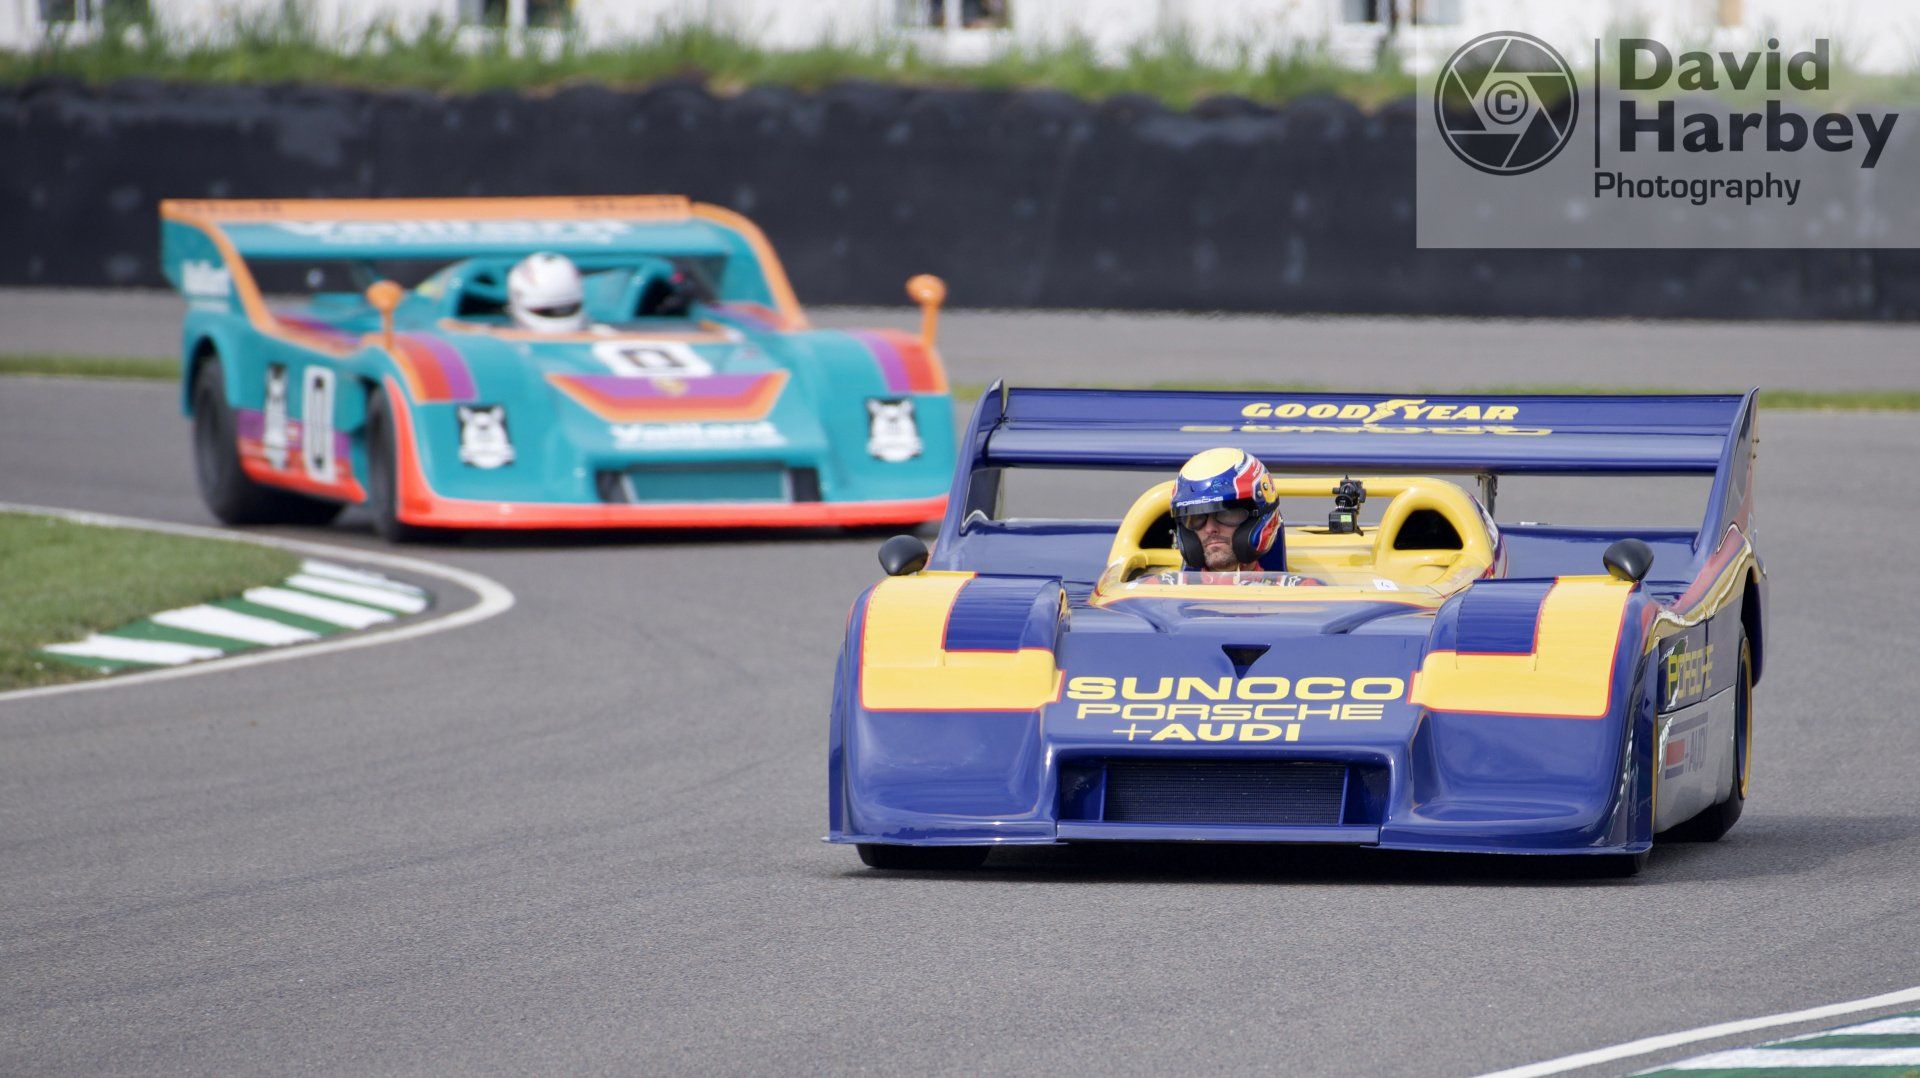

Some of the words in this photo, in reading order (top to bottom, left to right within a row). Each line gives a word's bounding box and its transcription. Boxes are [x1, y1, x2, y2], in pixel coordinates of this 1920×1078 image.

[1176, 496, 1224, 507] PORSCHE
[1066, 676, 1405, 700] SUNOCO
[1076, 703, 1384, 721] PORSCHE
